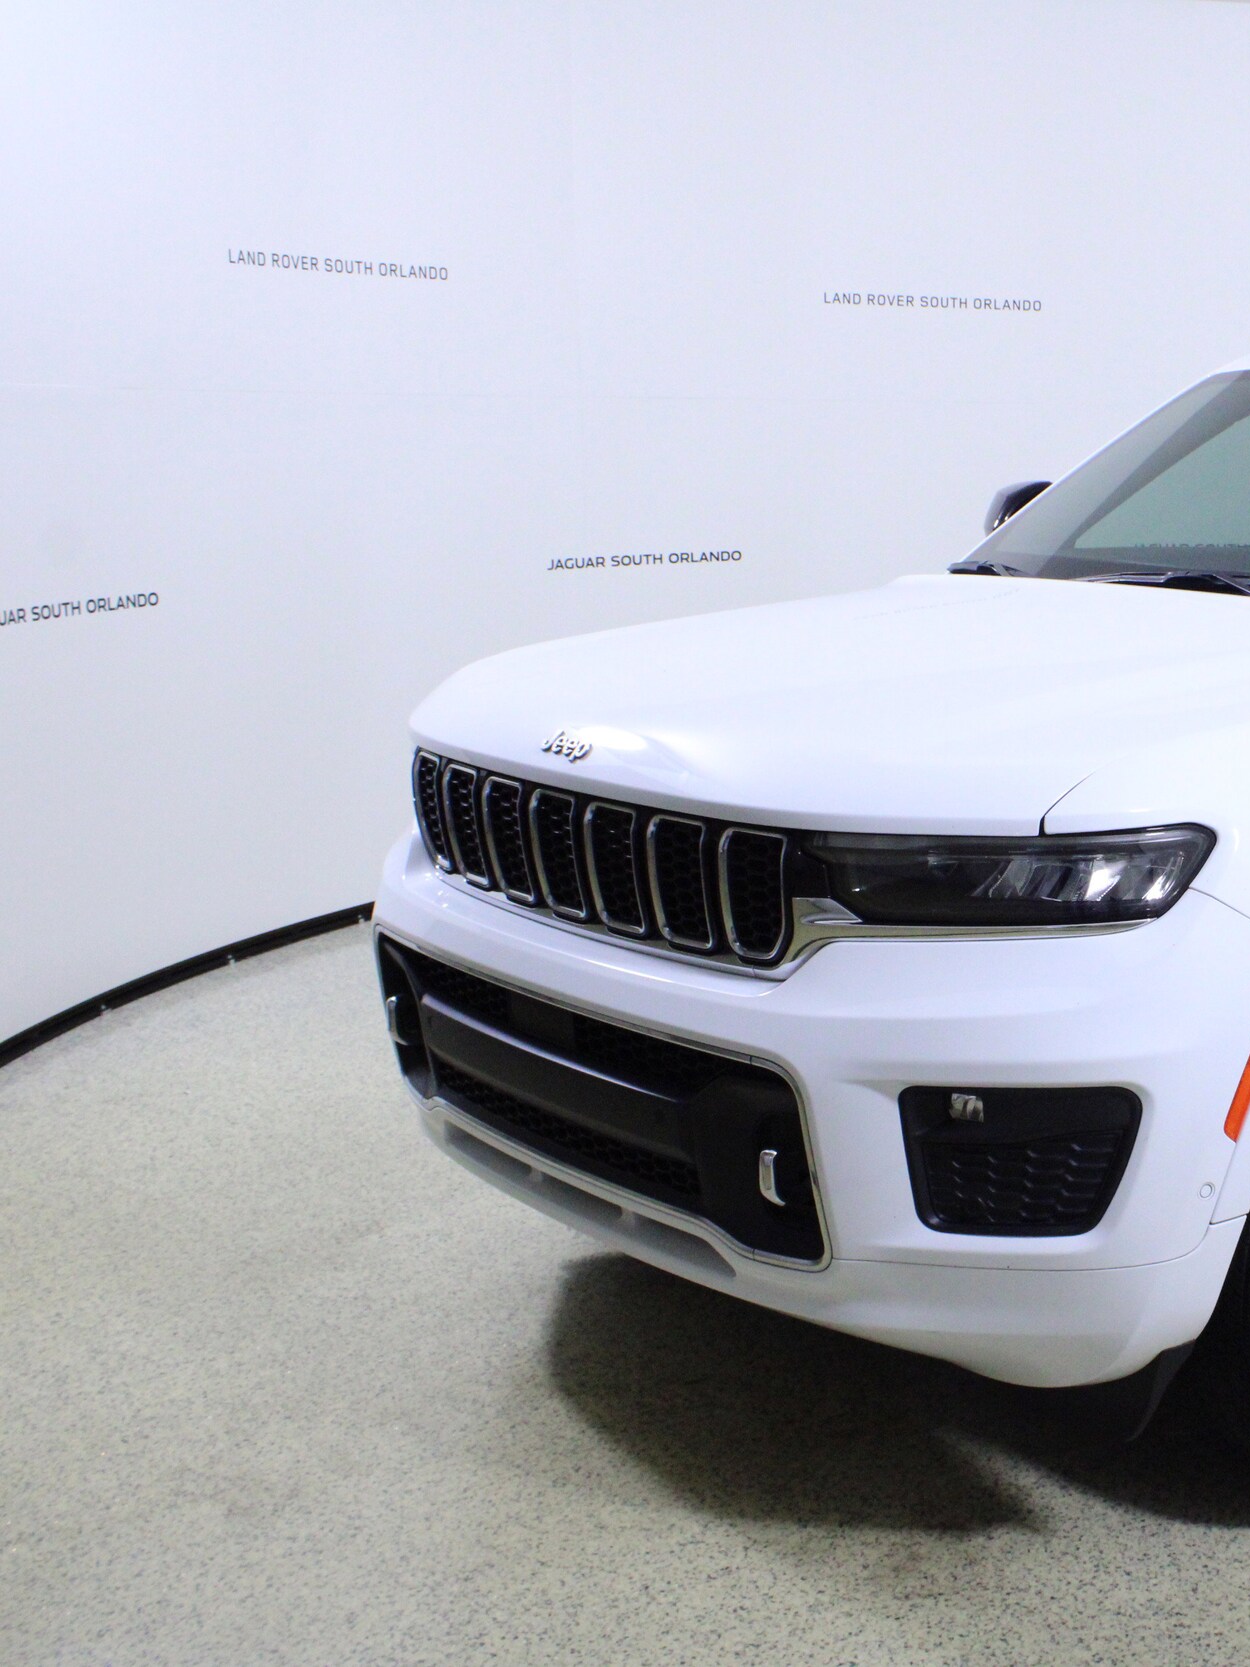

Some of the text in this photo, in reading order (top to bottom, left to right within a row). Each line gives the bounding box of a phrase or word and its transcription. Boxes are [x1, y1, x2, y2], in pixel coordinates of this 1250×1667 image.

[228, 248, 449, 281] LAND ROVER SOUTH ORLANDO
[823, 291, 1042, 312] LAND ROVER SOUTH ORLANDO
[547, 550, 743, 571] JAGUAR SOUTH ORLANDO
[31, 600, 82, 622] SOUTH
[86, 591, 160, 614] ORLANDO
[540, 730, 593, 763] Jeep
